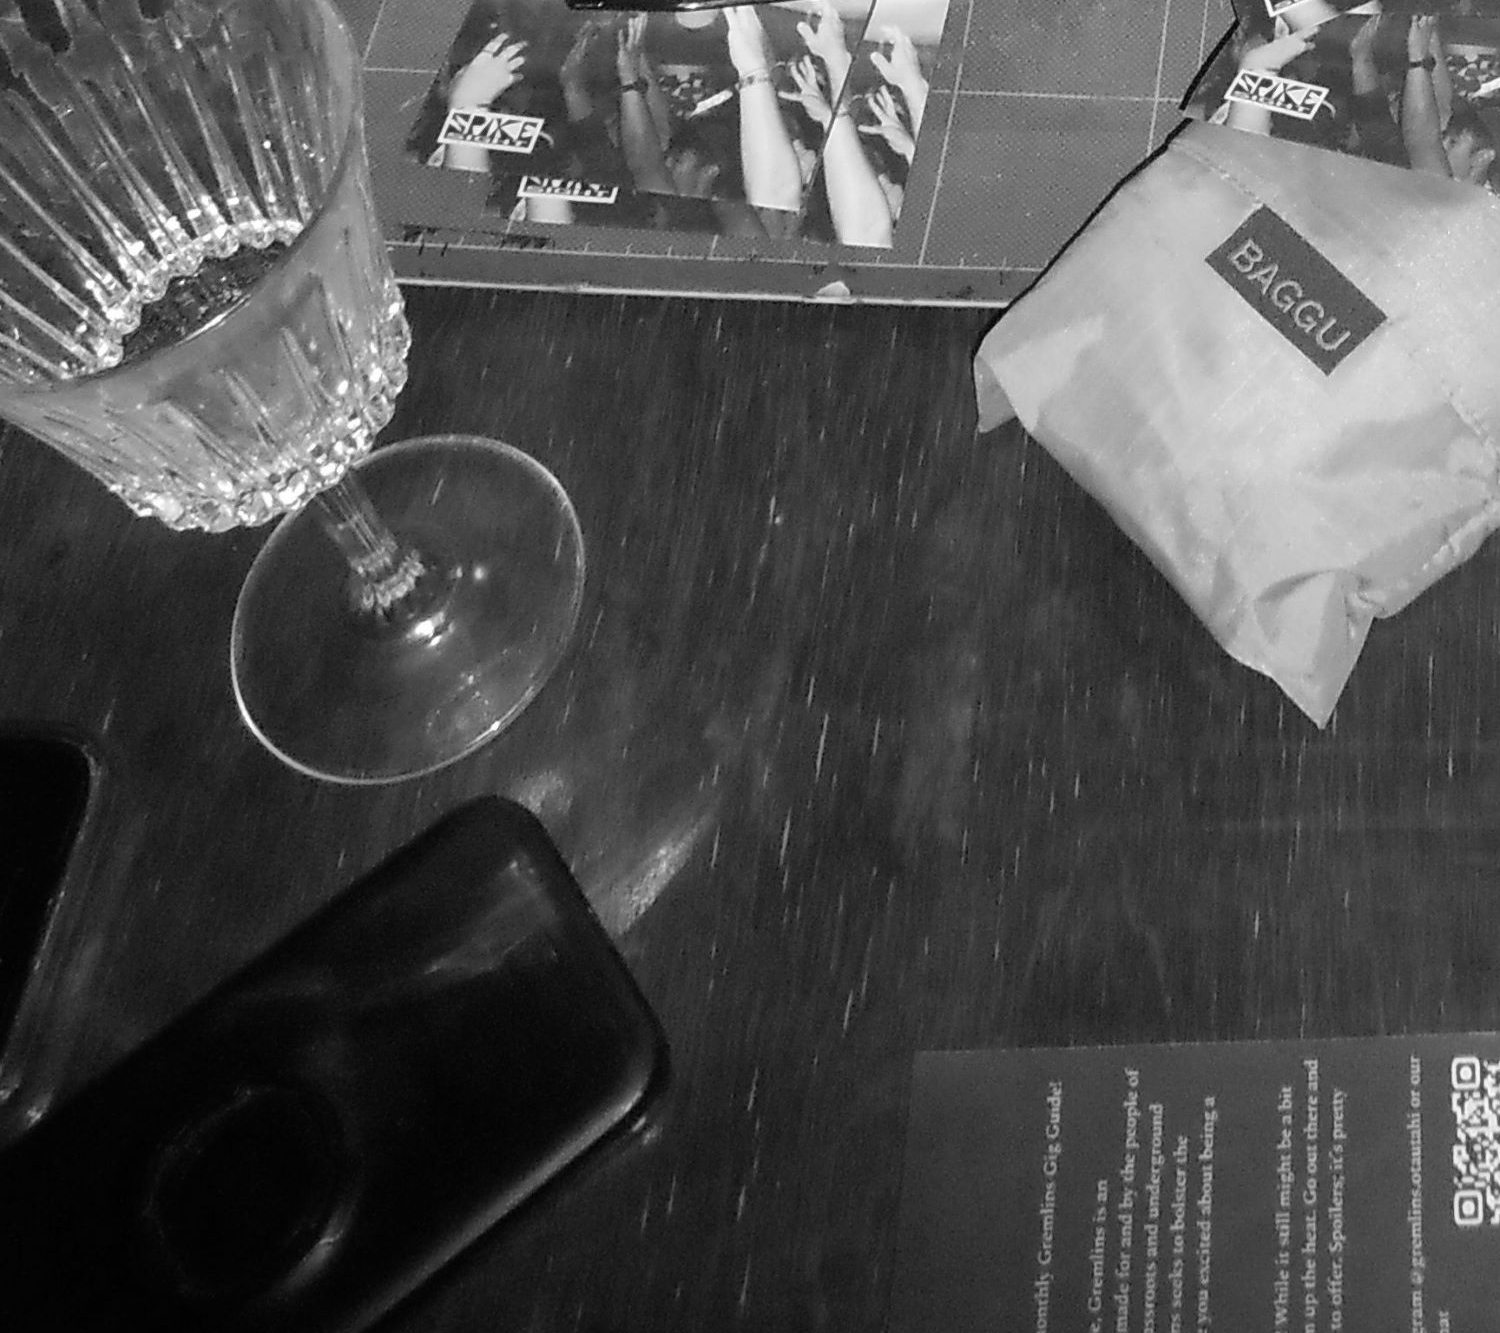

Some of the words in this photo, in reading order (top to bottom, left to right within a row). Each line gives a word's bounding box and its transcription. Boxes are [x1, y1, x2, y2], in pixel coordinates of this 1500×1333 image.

[1228, 238, 1352, 352] BAGGU
[1125, 1067, 1139, 1088] of
[1303, 1058, 1319, 1092] and
[1046, 1081, 1062, 1139] Guide!
[1205, 1095, 1216, 1108] a
[1278, 1086, 1292, 1111] bit
[1332, 1088, 1348, 1140] pretty
[1123, 1090, 1140, 1149] people
[1199, 1110, 1218, 1160] being
[1281, 1114, 1292, 1125] a
[1303, 1095, 1318, 1143] there
[1173, 1135, 1188, 1164] the
[1278, 1129, 1292, 1151] be
[1329, 1143, 1344, 1171] it's
[1043, 1143, 1062, 1177] Gig
[1120, 1154, 1135, 1182] the
[1305, 1147, 1317, 1174] out
[1098, 1180, 1108, 1203] an
[1197, 1166, 1213, 1215] about
[1277, 1154, 1294, 1207] might
[1303, 1178, 1317, 1206] Go
[1092, 1206, 1106, 1222] is
[1119, 1187, 1138, 1209] by
[1170, 1169, 1186, 1233] bolster
[1038, 1182, 1056, 1266] Gremlins
[1118, 1212, 1133, 1248] and
[1276, 1211, 1291, 1246] still
[1301, 1210, 1317, 1255] heat.
[1172, 1237, 1184, 1255] to
[1196, 1220, 1211, 1284] excited
[1275, 1251, 1290, 1267] it
[1088, 1229, 1105, 1313] Gremlins
[1115, 1252, 1130, 1279] for
[1302, 1260, 1317, 1289] the
[1328, 1256, 1343, 1306] offer.
[1035, 1274, 1054, 1333] onthly
[1169, 1260, 1184, 1316] seeks
[1274, 1270, 1290, 1326] While
[1114, 1284, 1130, 1333] made
[1198, 1289, 1212, 1324] you
[1304, 1293, 1319, 1318] up
[1331, 1311, 1342, 1331] to
